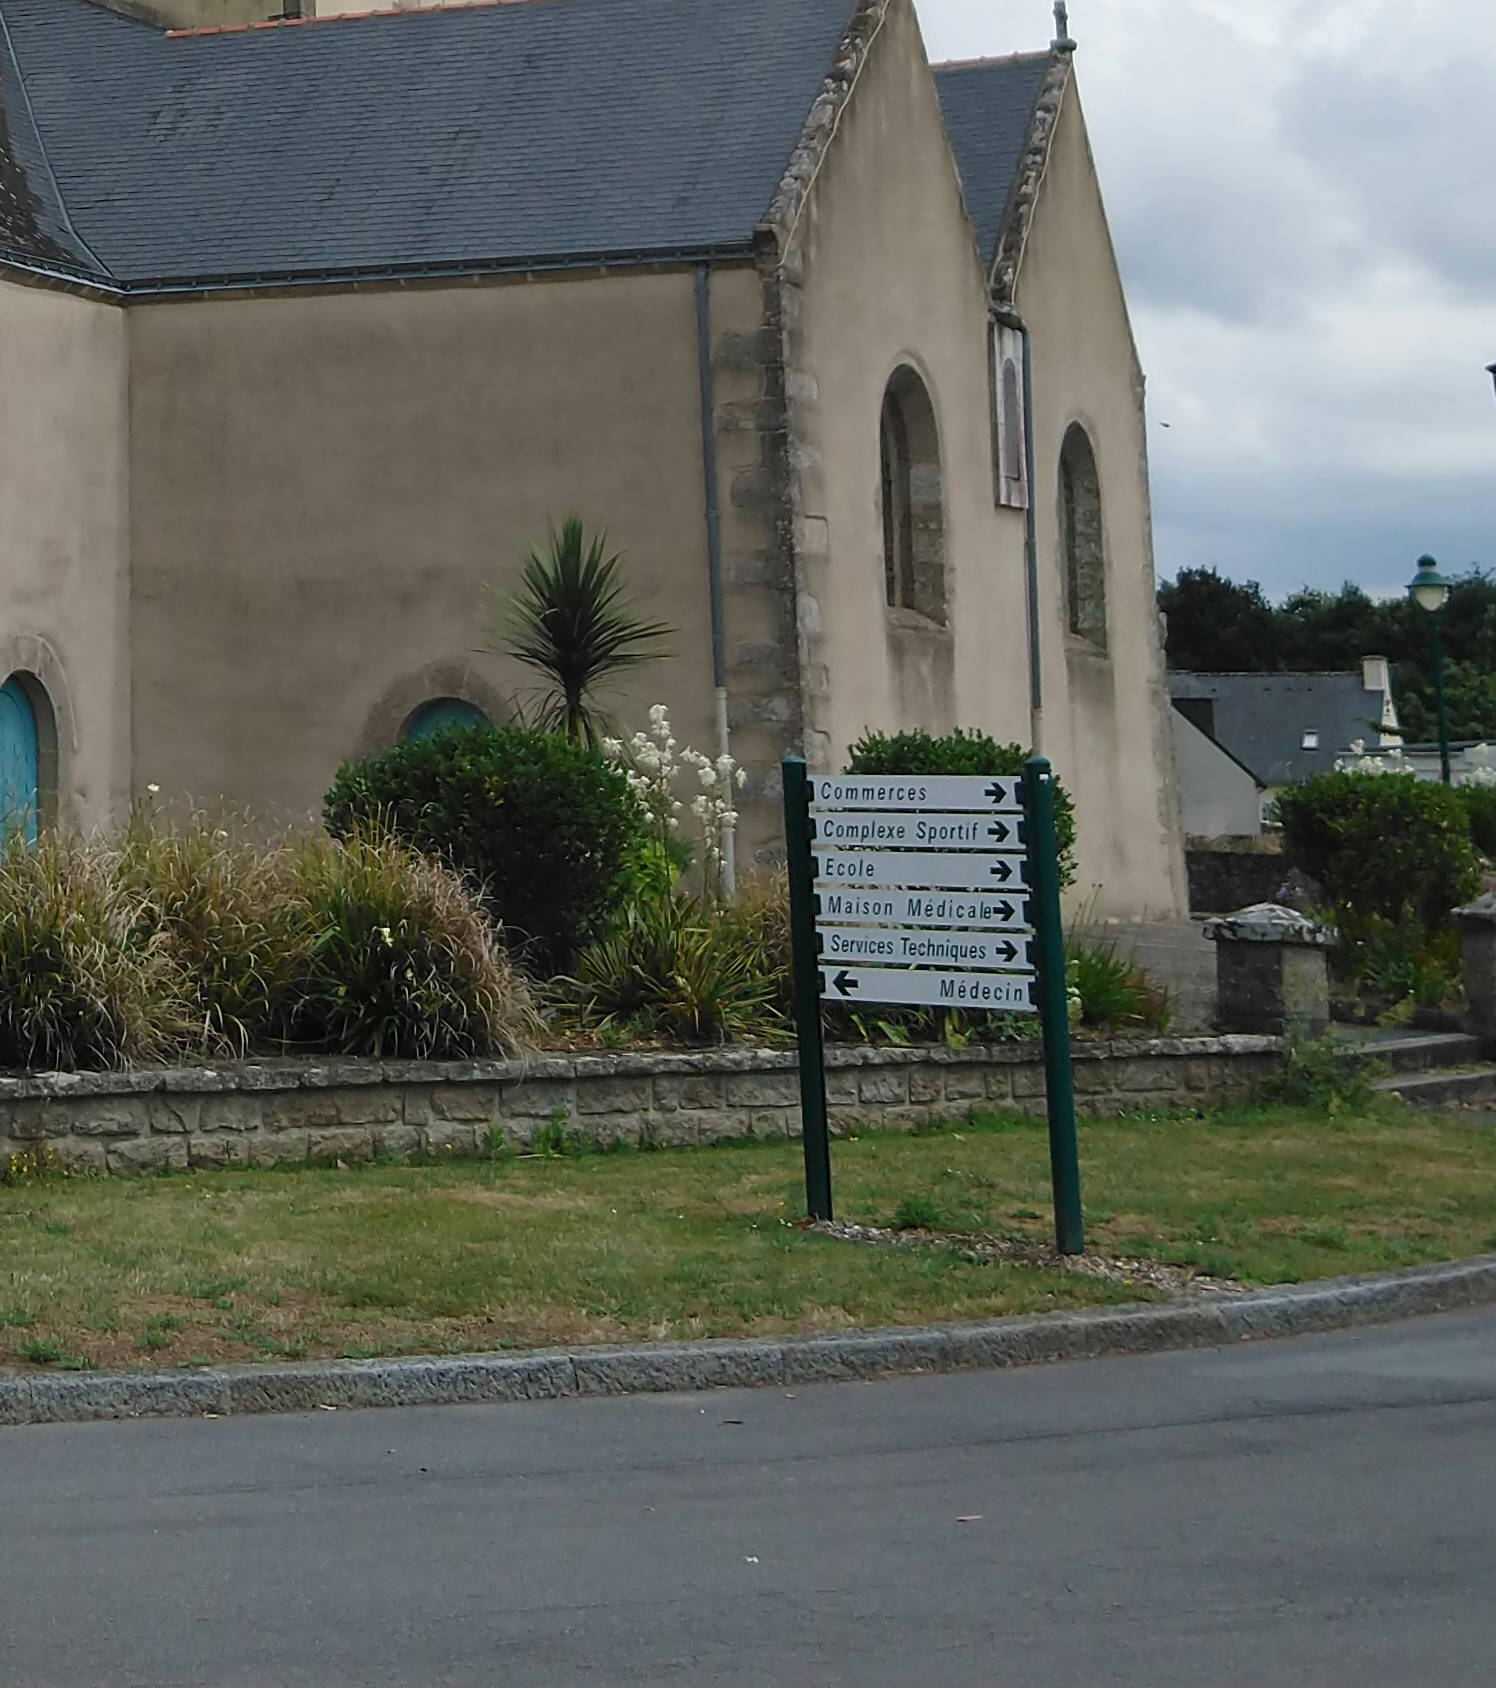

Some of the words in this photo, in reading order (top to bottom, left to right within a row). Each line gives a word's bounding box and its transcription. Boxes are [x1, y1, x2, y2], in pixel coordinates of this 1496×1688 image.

[821, 782, 927, 801] Commerces
[823, 820, 905, 843] Complexe
[916, 821, 978, 843] Sportif
[826, 858, 875, 878] Ecole
[828, 896, 893, 916] Maison
[907, 898, 992, 920] Médicale
[831, 935, 893, 955] Services
[901, 938, 986, 963] Techniques
[940, 979, 1022, 1002] Médecin
